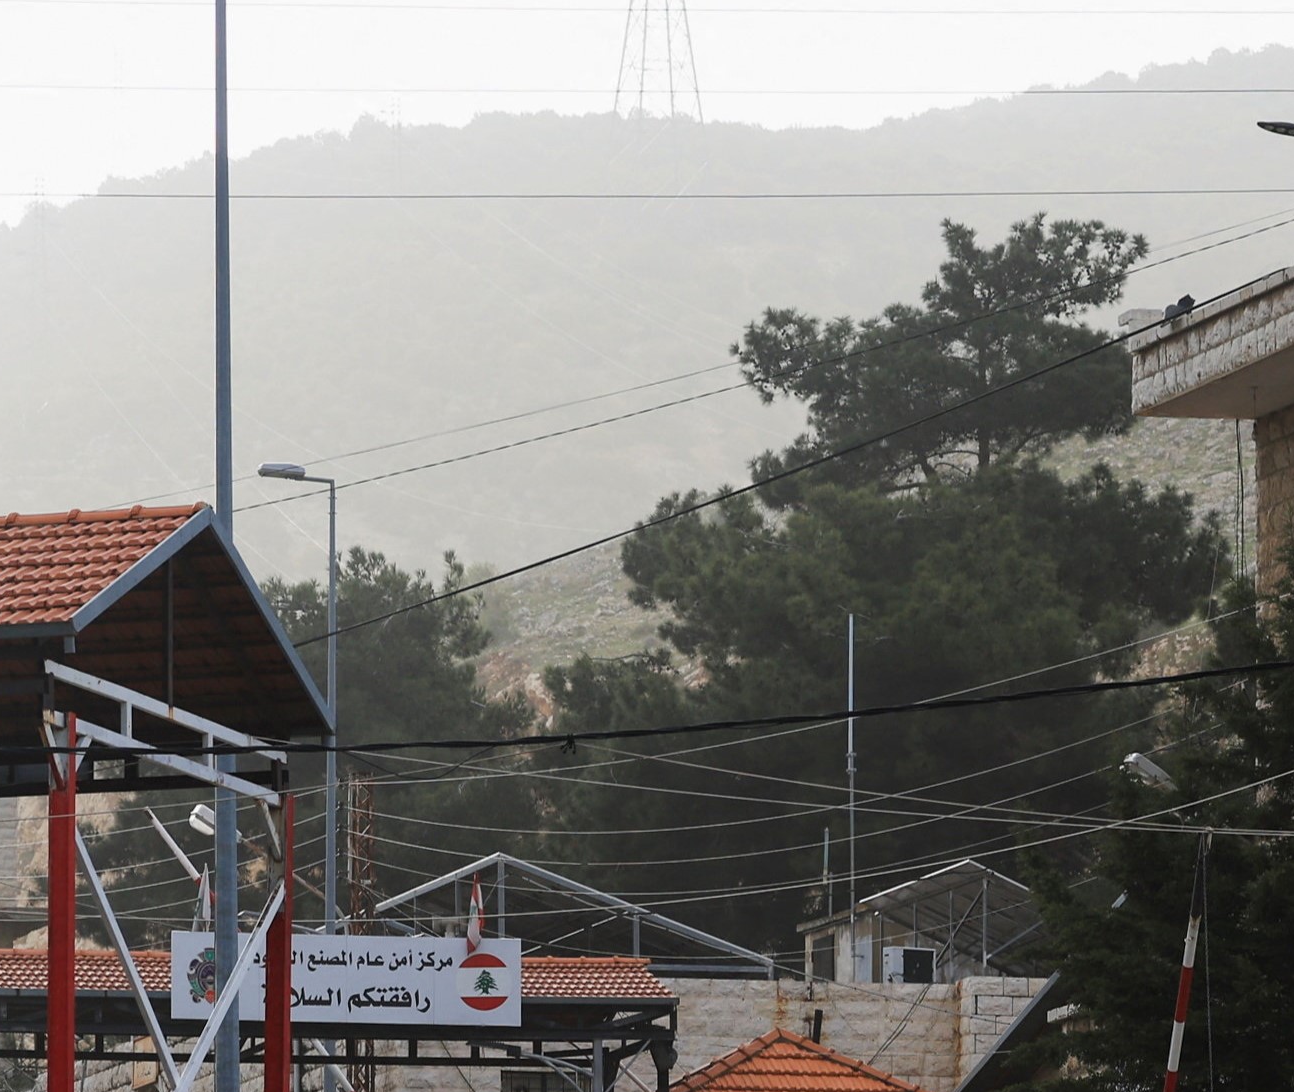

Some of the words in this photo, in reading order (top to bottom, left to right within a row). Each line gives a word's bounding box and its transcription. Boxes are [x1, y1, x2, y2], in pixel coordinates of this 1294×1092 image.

[307, 949, 352, 971] المصنع
[357, 951, 385, 971] عام
[388, 949, 413, 971] أمن
[416, 951, 453, 971] مركز
[347, 986, 431, 1013] رافقتكم
